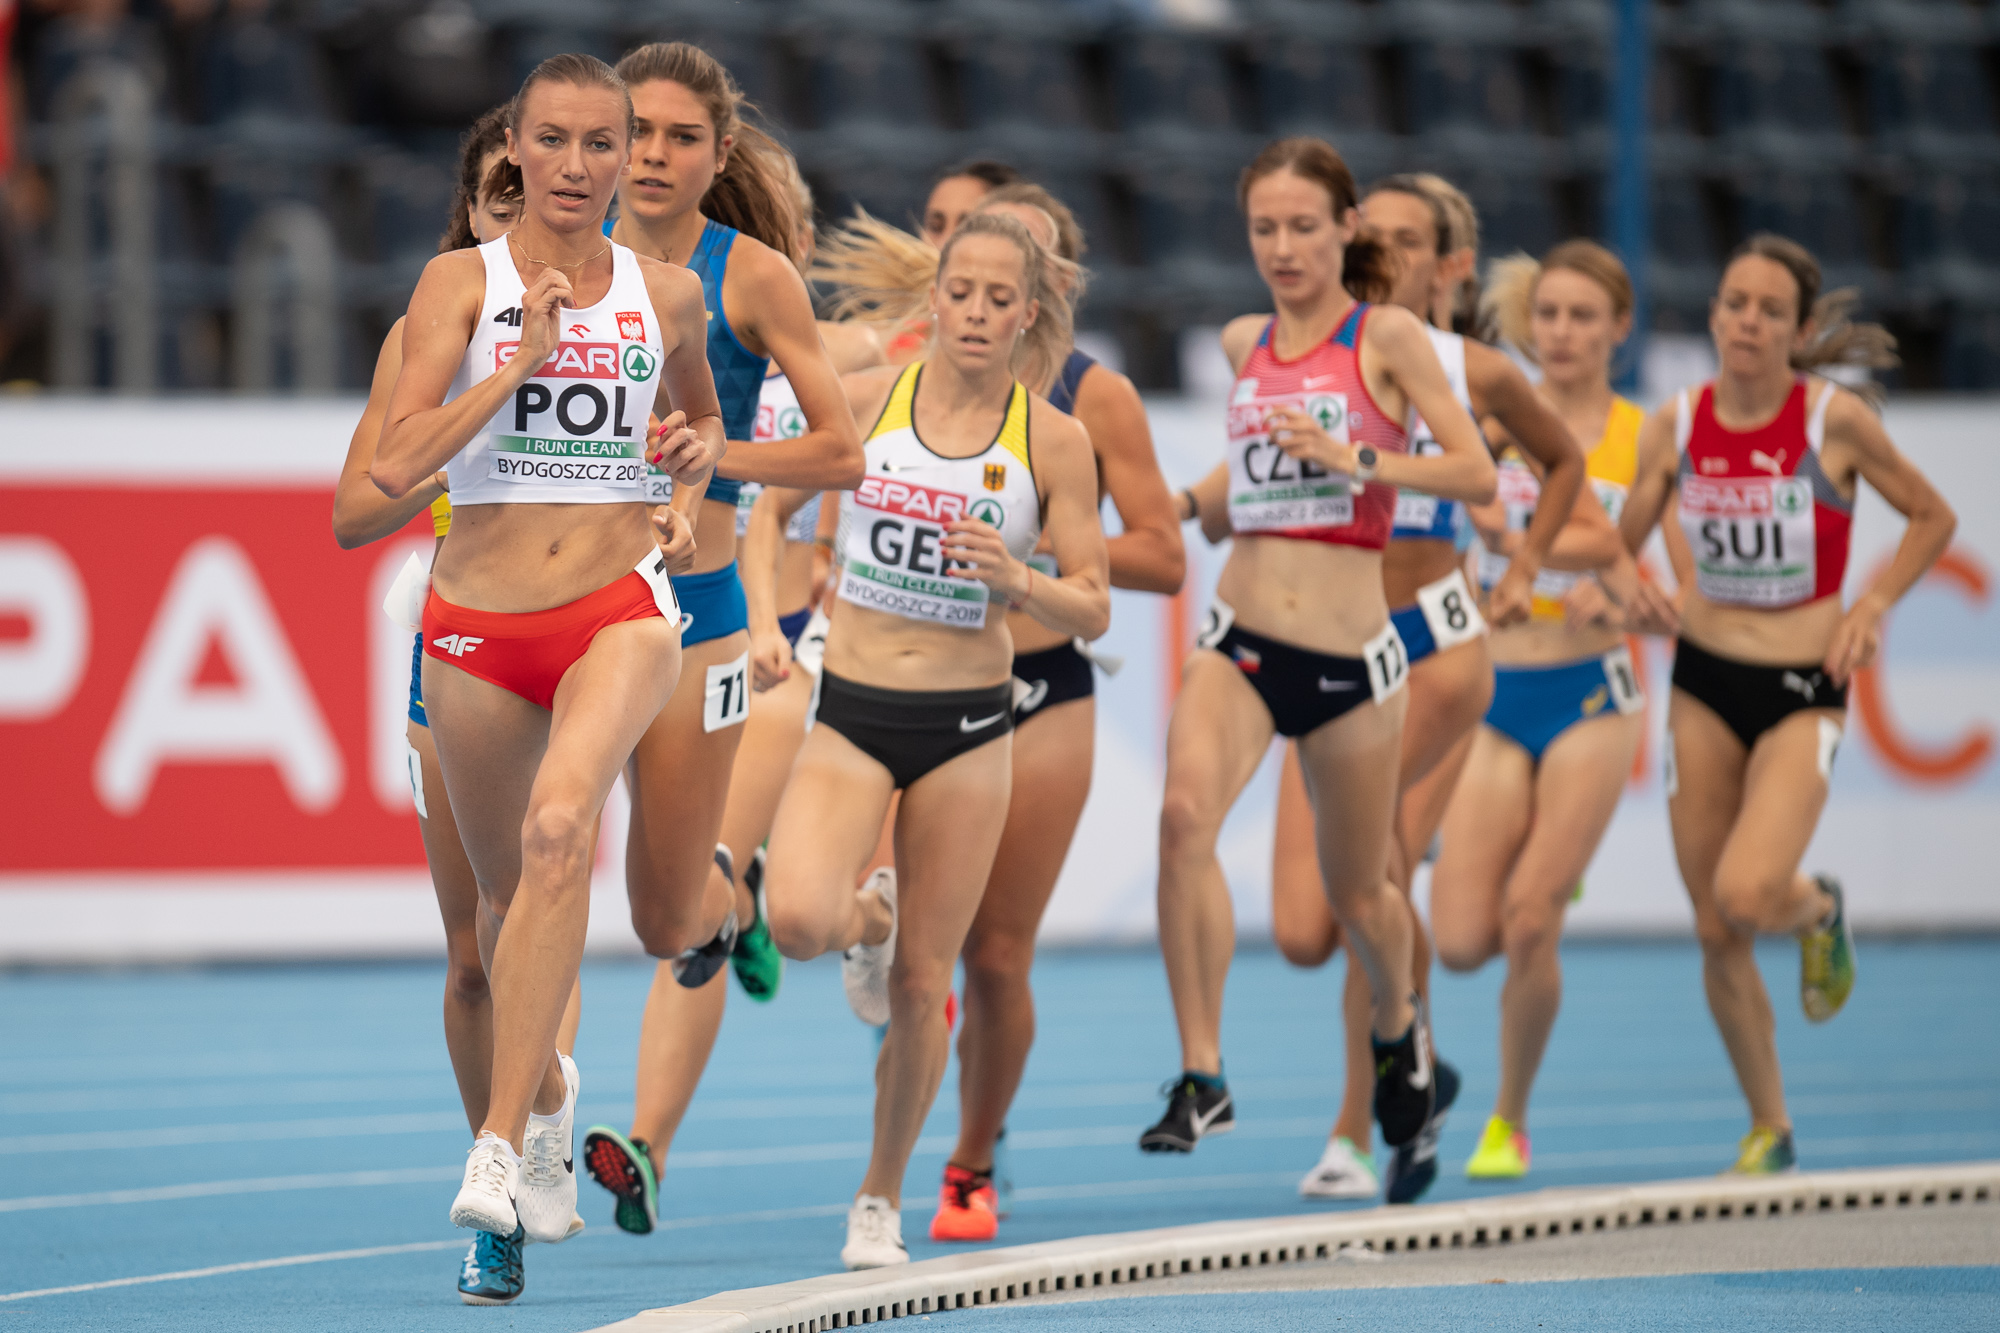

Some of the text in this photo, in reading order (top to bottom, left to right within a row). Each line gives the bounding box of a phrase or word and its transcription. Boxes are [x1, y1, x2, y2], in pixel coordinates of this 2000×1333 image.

[515, 383, 633, 436] POL
[526, 439, 531, 452] I
[534, 440, 567, 454] RUN
[498, 458, 611, 481] BYDGOSZCZ
[615, 464, 640, 481] 201
[856, 480, 964, 523] SPAR
[1701, 519, 1784, 563] SUI
[846, 579, 983, 621] BYDGOSZCZ 2019
[875, 570, 904, 588] RUN
[1442, 590, 1468, 631] 8
[433, 633, 485, 657] 4F
[1374, 637, 1403, 688] 12
[719, 668, 744, 719] 11
